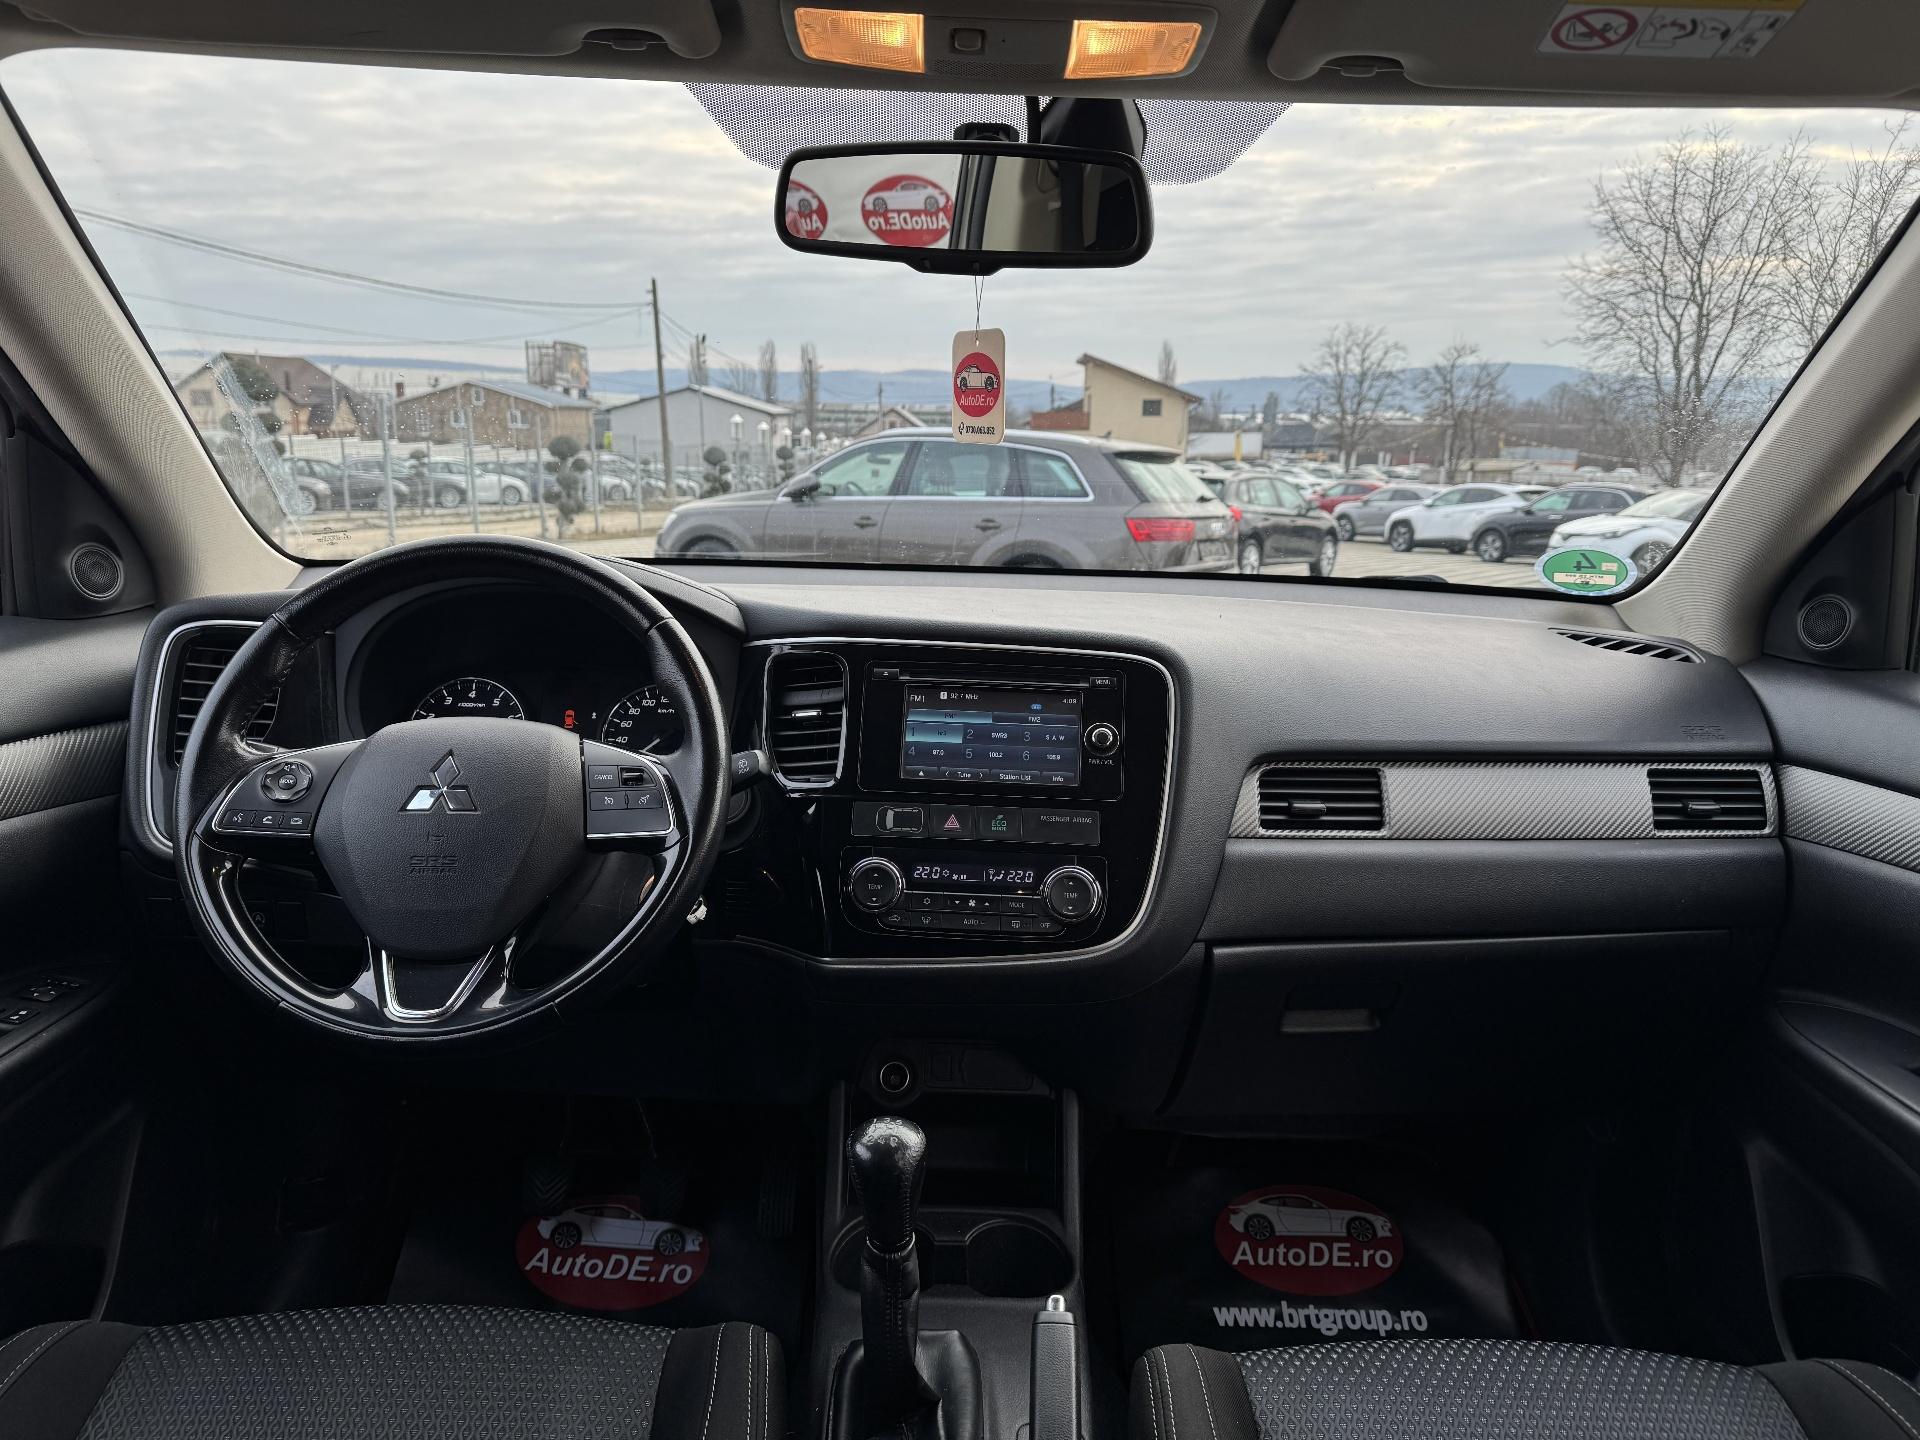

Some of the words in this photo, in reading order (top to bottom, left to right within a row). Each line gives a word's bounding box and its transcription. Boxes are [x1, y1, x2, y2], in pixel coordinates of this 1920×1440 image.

[960, 394, 995, 406] AutoDE.ro
[468, 690, 477, 699] 4
[444, 696, 453, 705] 3
[492, 698, 501, 706] 5
[642, 699, 656, 707] 100
[620, 720, 633, 728] 60
[966, 729, 974, 739] 2
[1023, 731, 1031, 742] 3
[908, 746, 916, 756] 4
[965, 748, 973, 759] 5
[1022, 750, 1030, 761] 6
[991, 819, 1007, 827] ECO
[913, 866, 940, 879] 22.0
[1007, 870, 1034, 883] 22.0
[1232, 1241, 1393, 1269] AutoDE.ro
[524, 1247, 693, 1285] AutoDE.ro
[1212, 1300, 1428, 1337] www.brtgroup.ro
